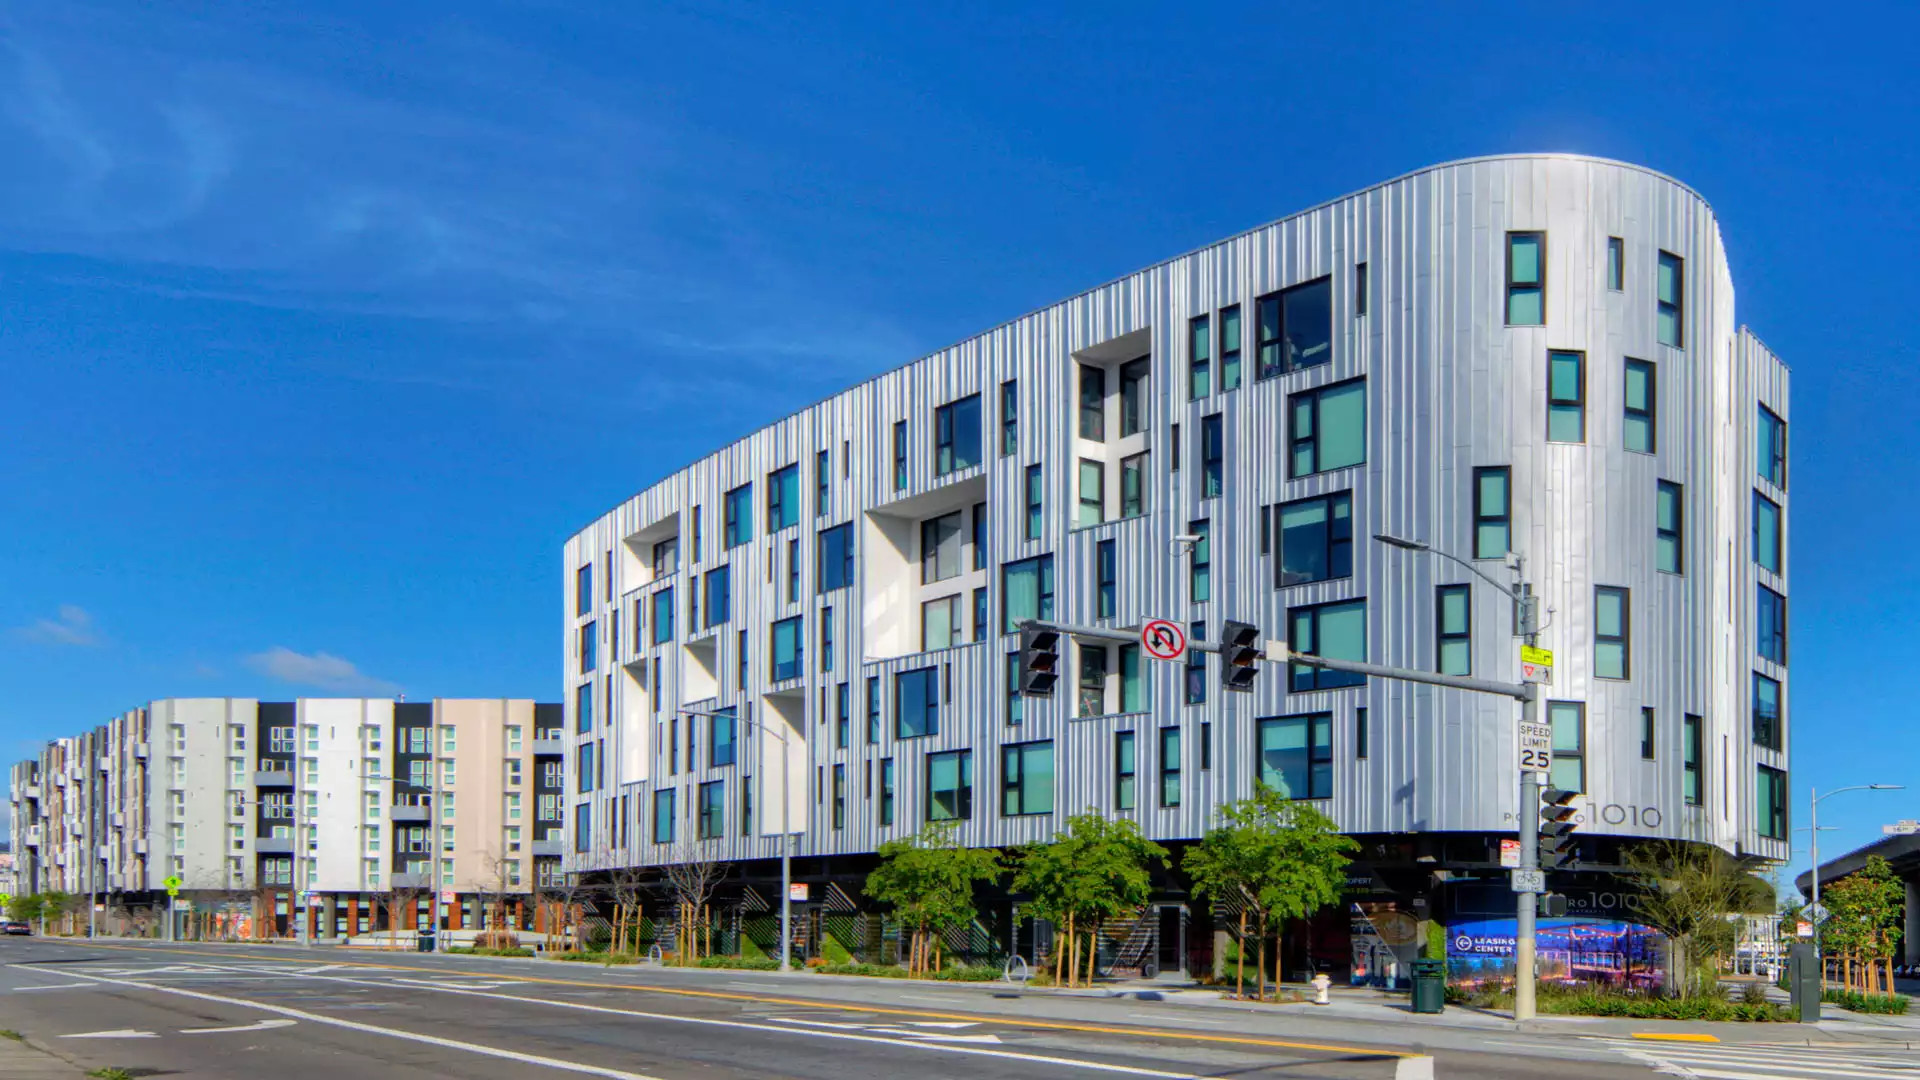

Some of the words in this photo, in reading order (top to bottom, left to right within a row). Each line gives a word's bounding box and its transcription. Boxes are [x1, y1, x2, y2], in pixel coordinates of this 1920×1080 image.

[1520, 725, 1551, 738] SPEED
[1522, 737, 1548, 749] LIMIT
[1521, 749, 1549, 768] 25
[1474, 937, 1516, 946] LEASING
[1474, 945, 1513, 953] CENTER
